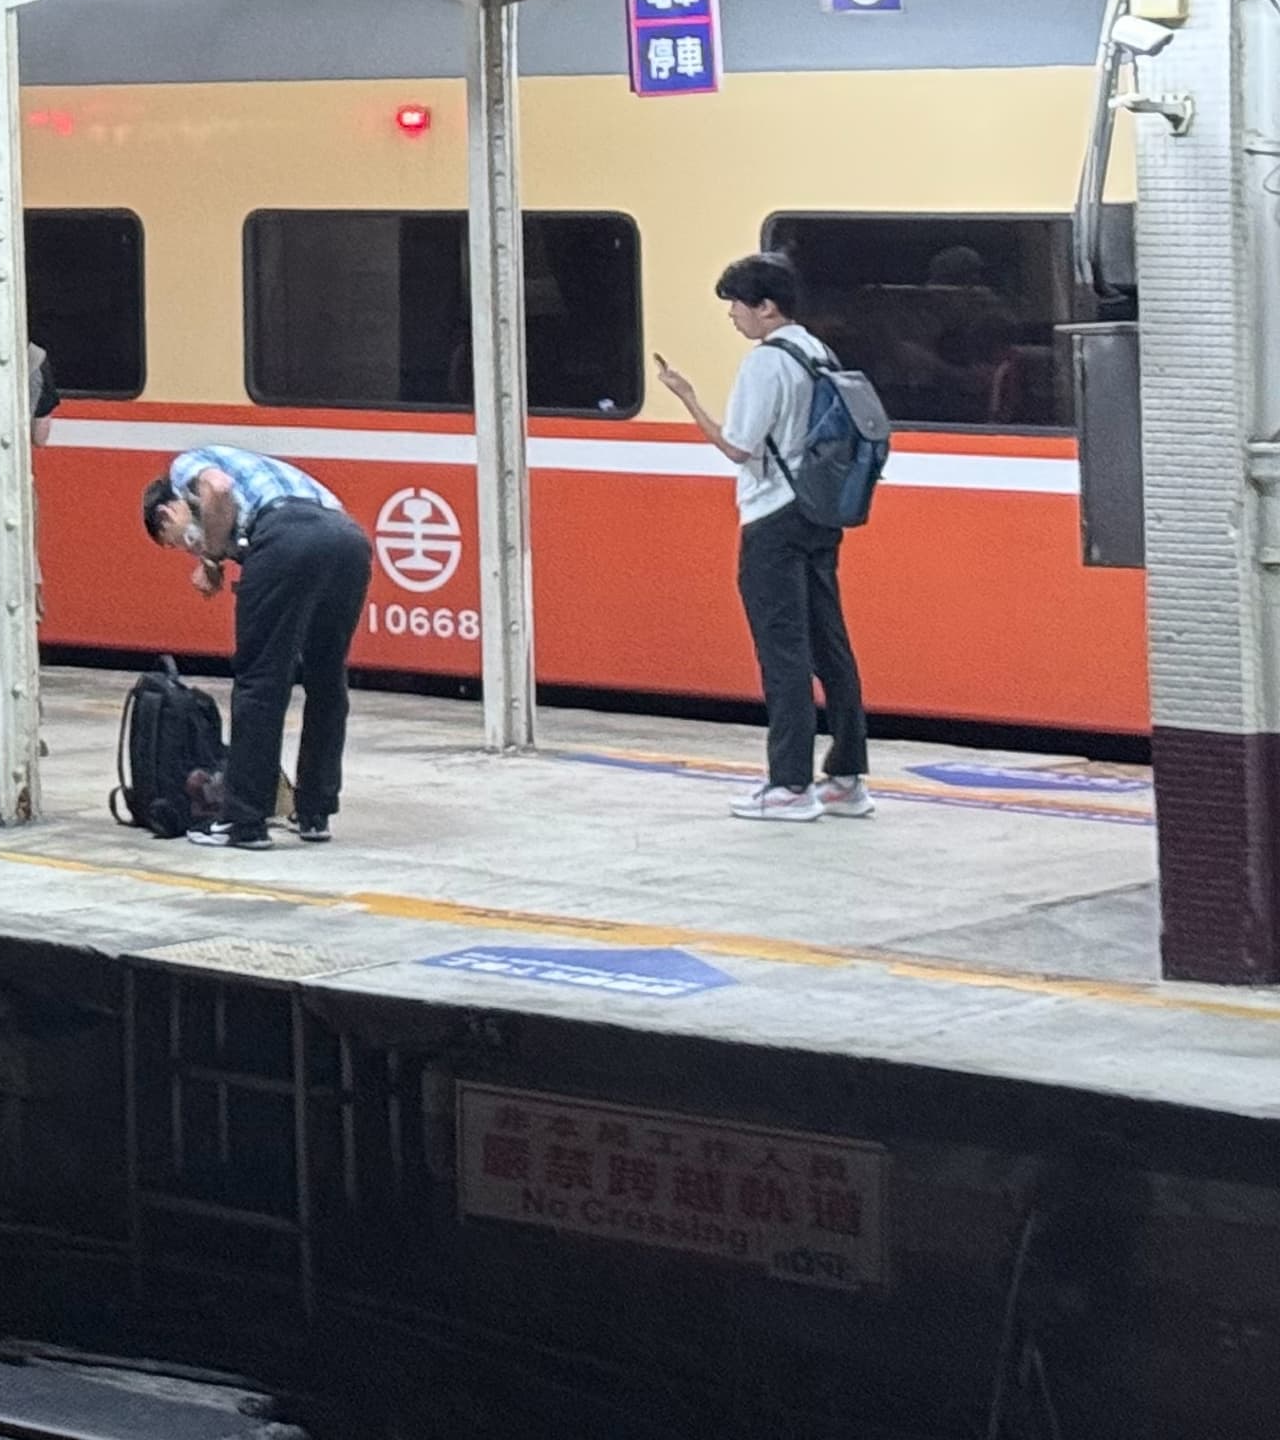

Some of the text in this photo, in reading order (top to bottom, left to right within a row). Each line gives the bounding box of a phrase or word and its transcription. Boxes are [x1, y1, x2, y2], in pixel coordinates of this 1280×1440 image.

[647, 35, 705, 79] 停車
[367, 601, 481, 641] 10668
[481, 1133, 863, 1237] 嚴禁跨越軌道
[521, 1188, 570, 1218] No
